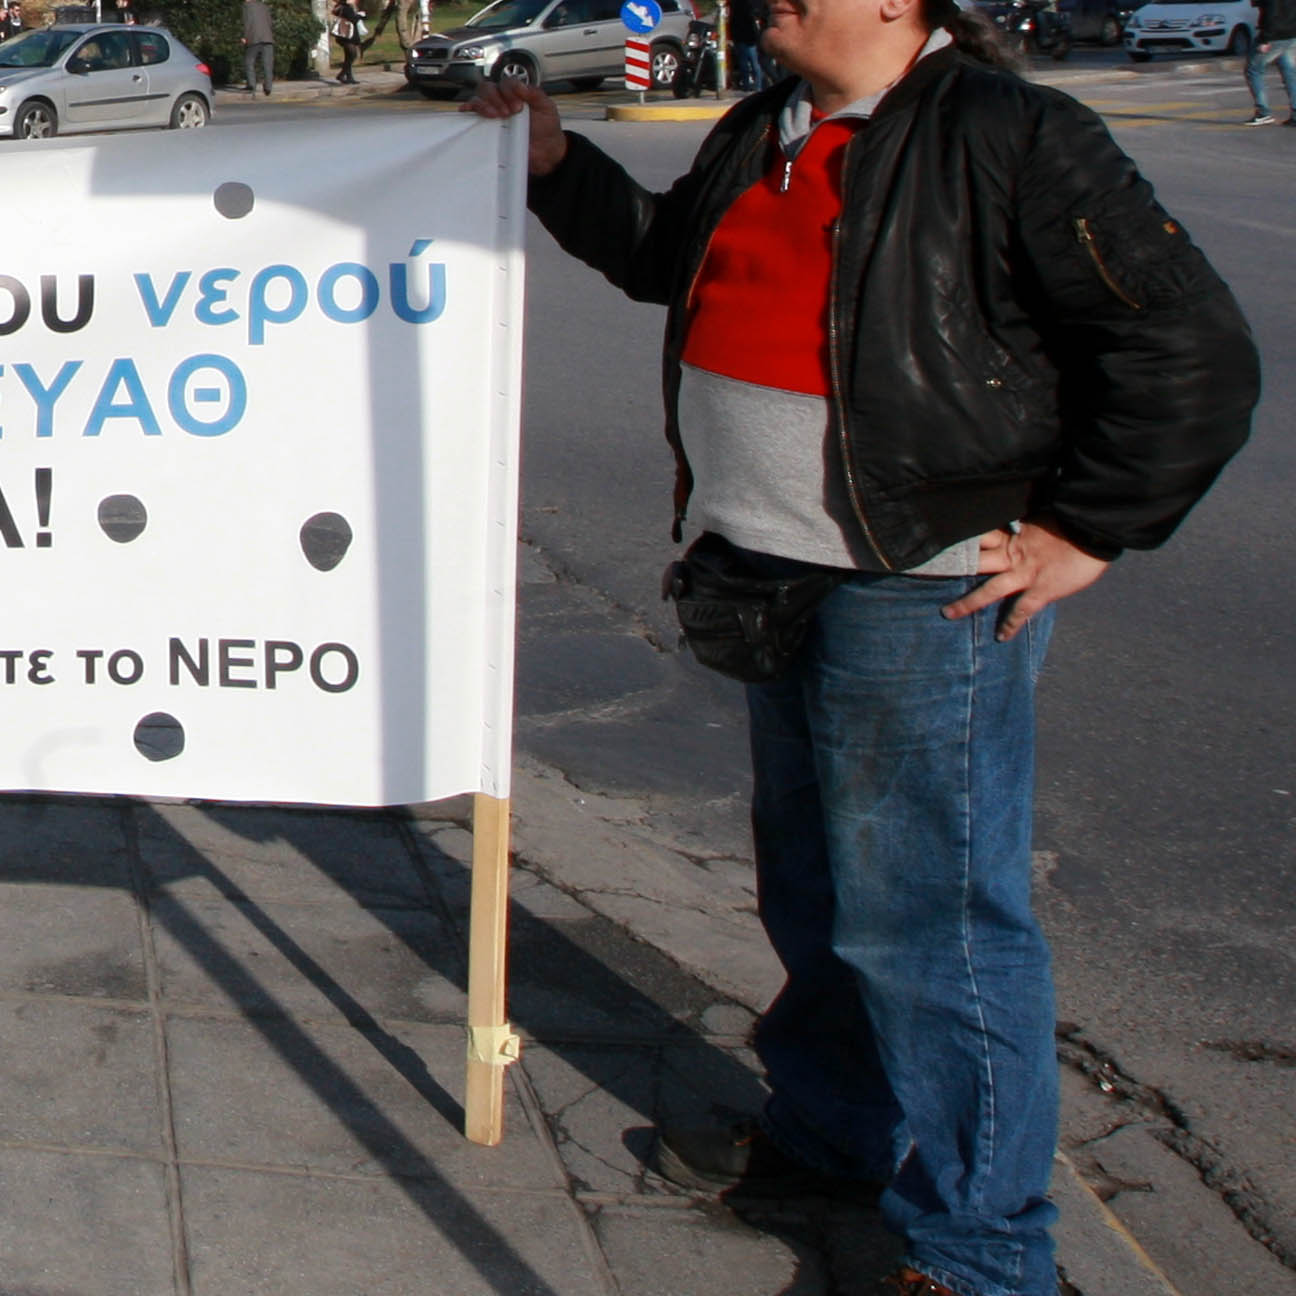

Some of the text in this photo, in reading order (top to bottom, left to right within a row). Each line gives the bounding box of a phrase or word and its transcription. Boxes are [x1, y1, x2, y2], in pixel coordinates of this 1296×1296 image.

[135, 239, 446, 346] νερού
[75, 648, 145, 686] το
[168, 637, 360, 694] ΝΕΡΟ
